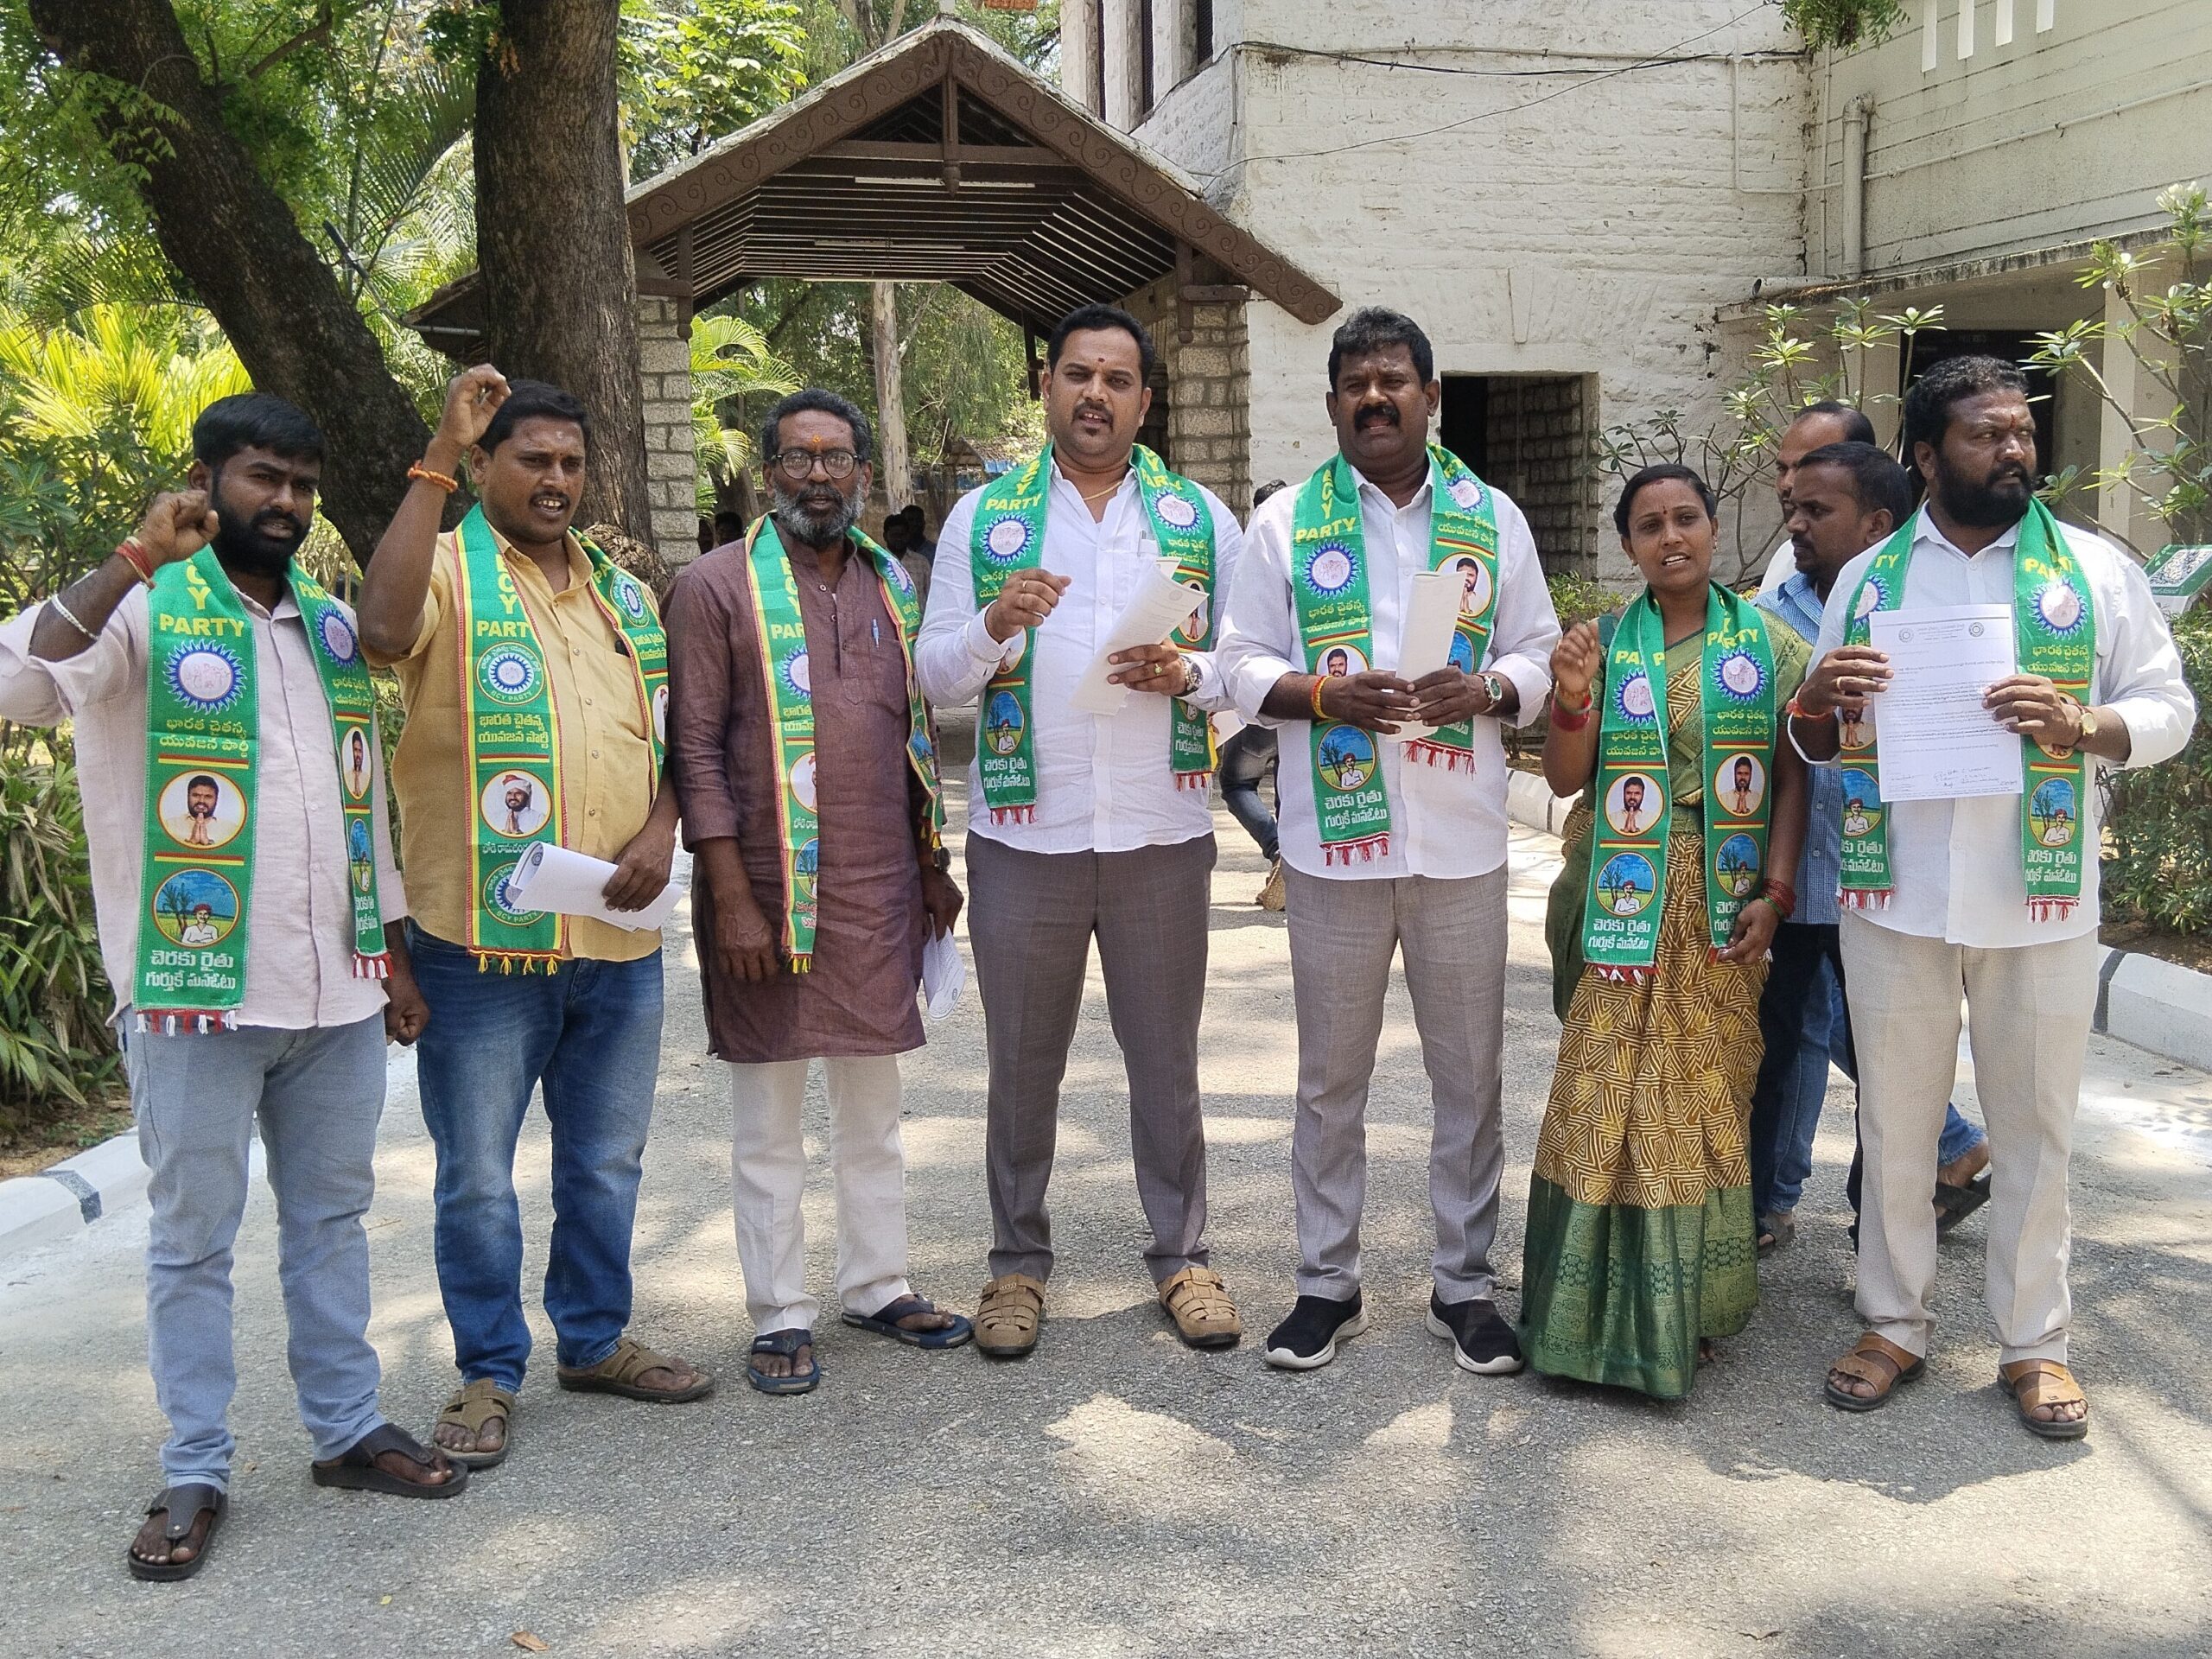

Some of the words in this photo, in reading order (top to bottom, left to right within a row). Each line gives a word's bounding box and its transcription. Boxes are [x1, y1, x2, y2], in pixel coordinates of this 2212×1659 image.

[985, 493, 1043, 511] PARTY
[1295, 517, 1357, 543] PARTY
[159, 613, 245, 638] PARTY
[1614, 650, 1643, 664] PA
[480, 714, 512, 727] భారత
[479, 730, 524, 743] యువజన
[1640, 729, 1660, 744] చైత
[1325, 793, 1355, 810] చెరకు
[1356, 790, 1382, 809] రైతు
[1857, 840, 1884, 858] రైతు
[1593, 918, 1624, 931] చెరకు
[1626, 919, 1651, 936] రైతు
[150, 950, 196, 967] చెరకు
[200, 951, 234, 972] రైతు
